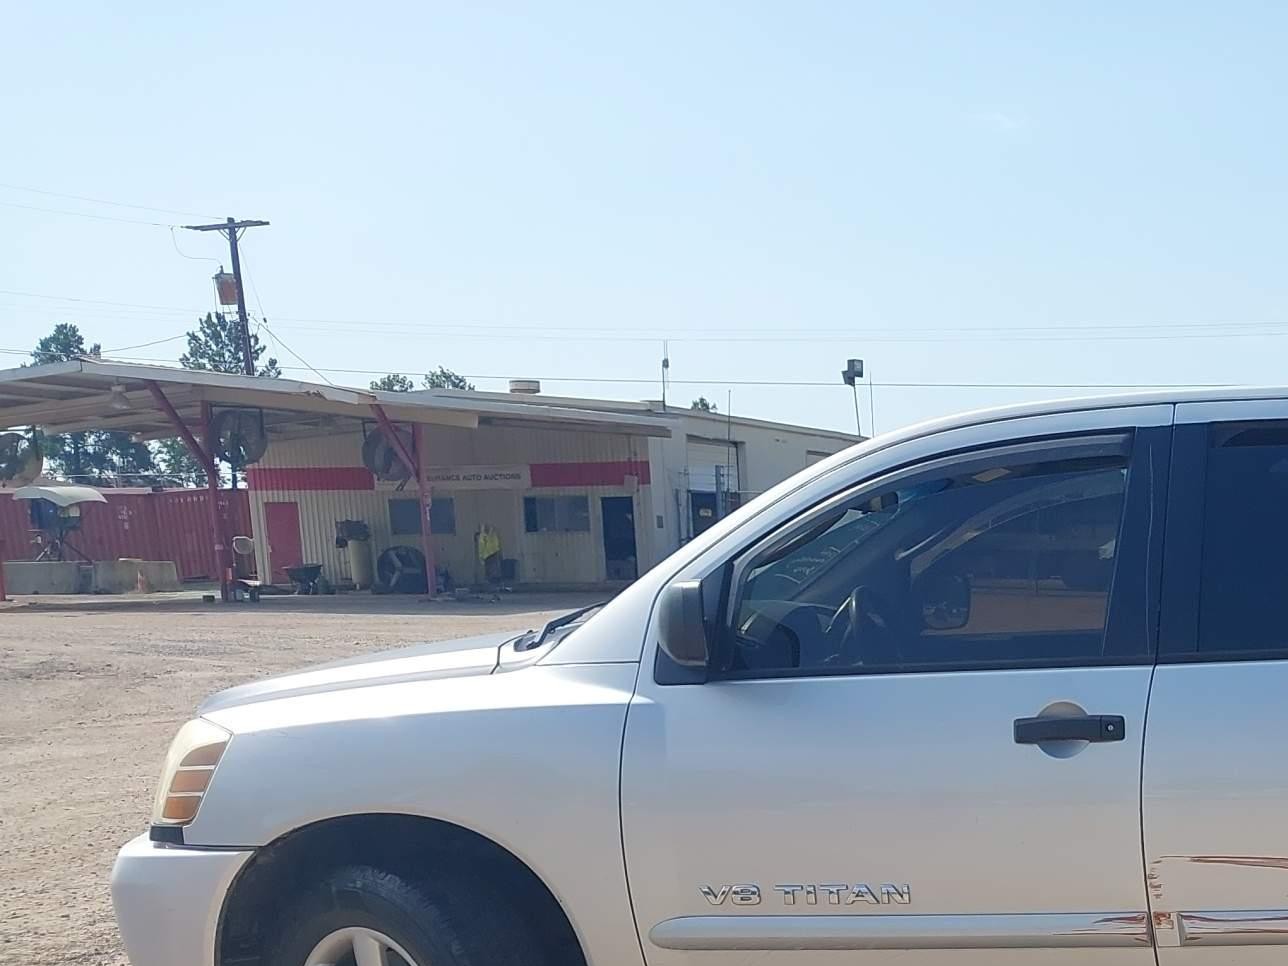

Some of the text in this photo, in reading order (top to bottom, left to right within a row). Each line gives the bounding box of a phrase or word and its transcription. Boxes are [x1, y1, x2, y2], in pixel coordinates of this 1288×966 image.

[462, 473, 482, 481] AUTO
[484, 472, 521, 480] AUCTIONS
[699, 883, 912, 905] V8 TITAN
